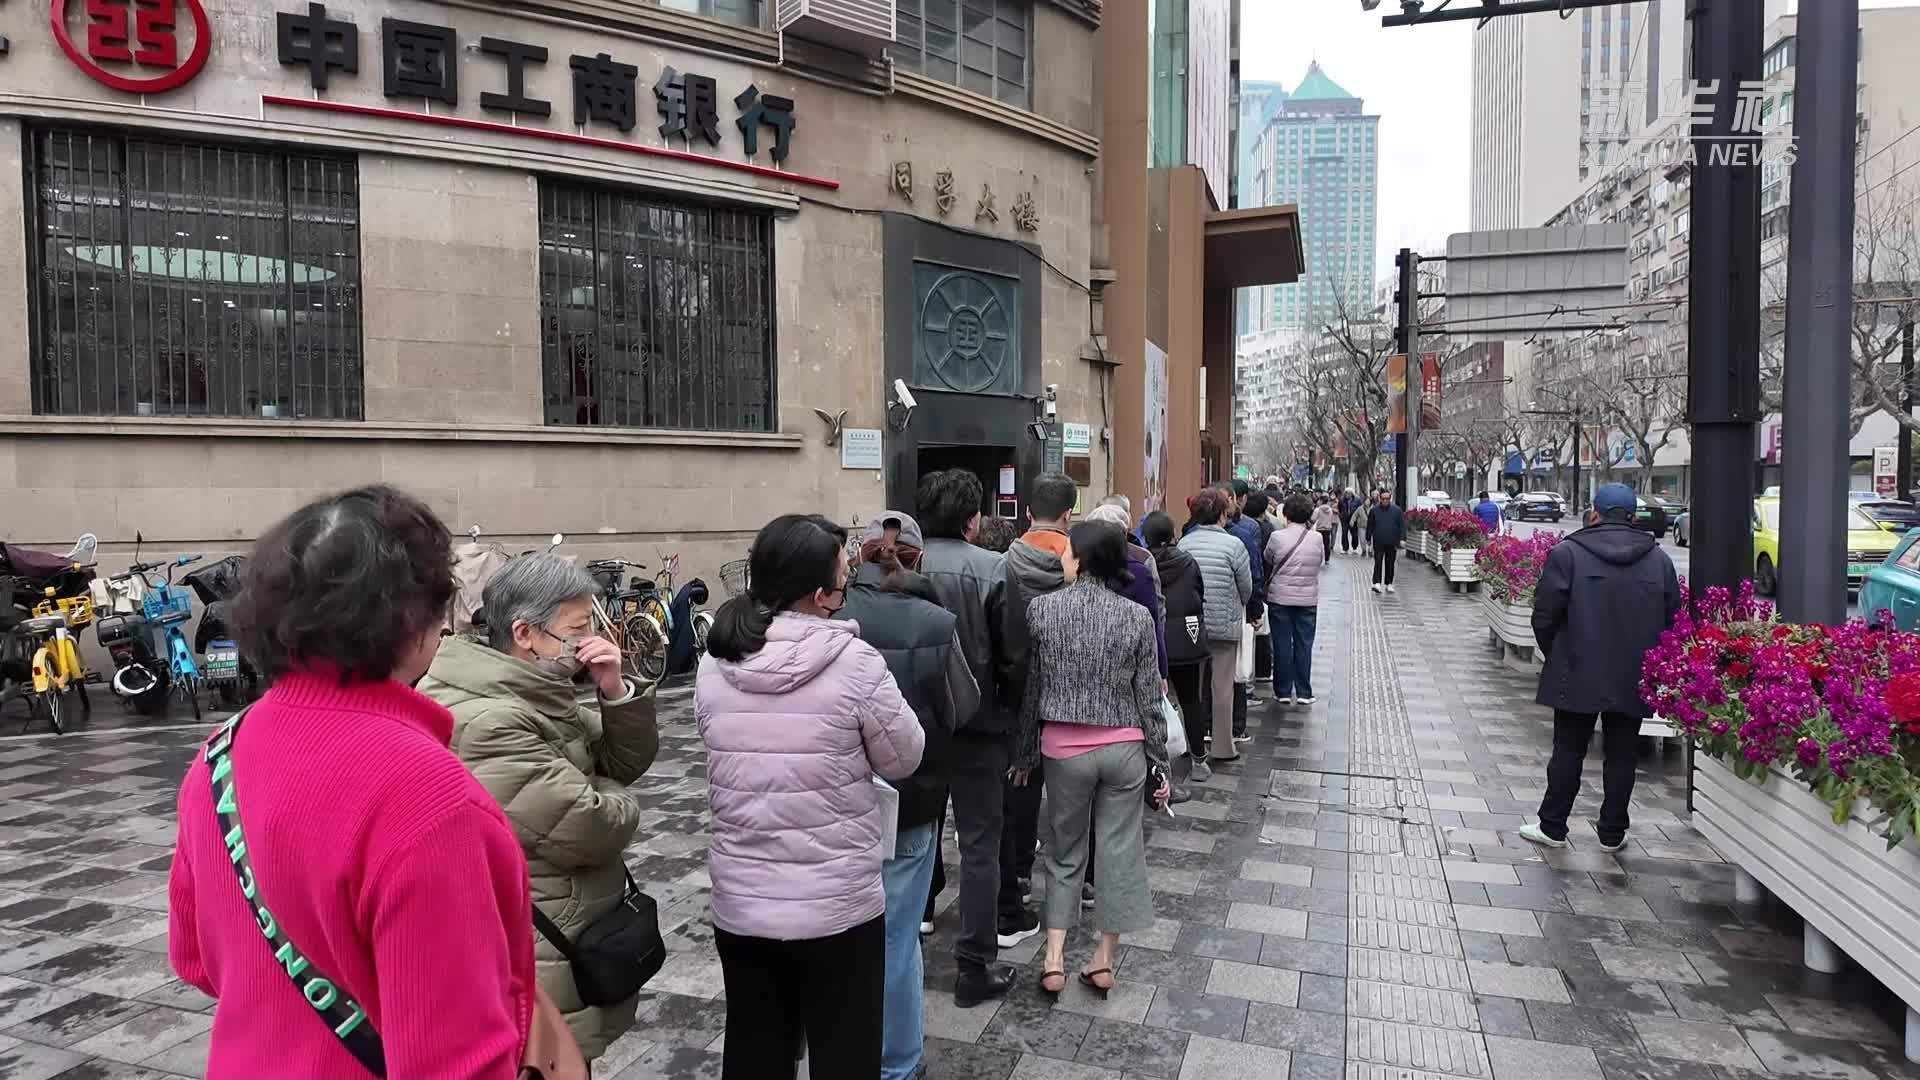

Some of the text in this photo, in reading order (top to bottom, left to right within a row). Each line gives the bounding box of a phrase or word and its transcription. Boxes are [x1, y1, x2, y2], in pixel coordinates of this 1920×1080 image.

[278, 2, 796, 162] 中国工商银行
[206, 735, 367, 1039] LONGCHAM
